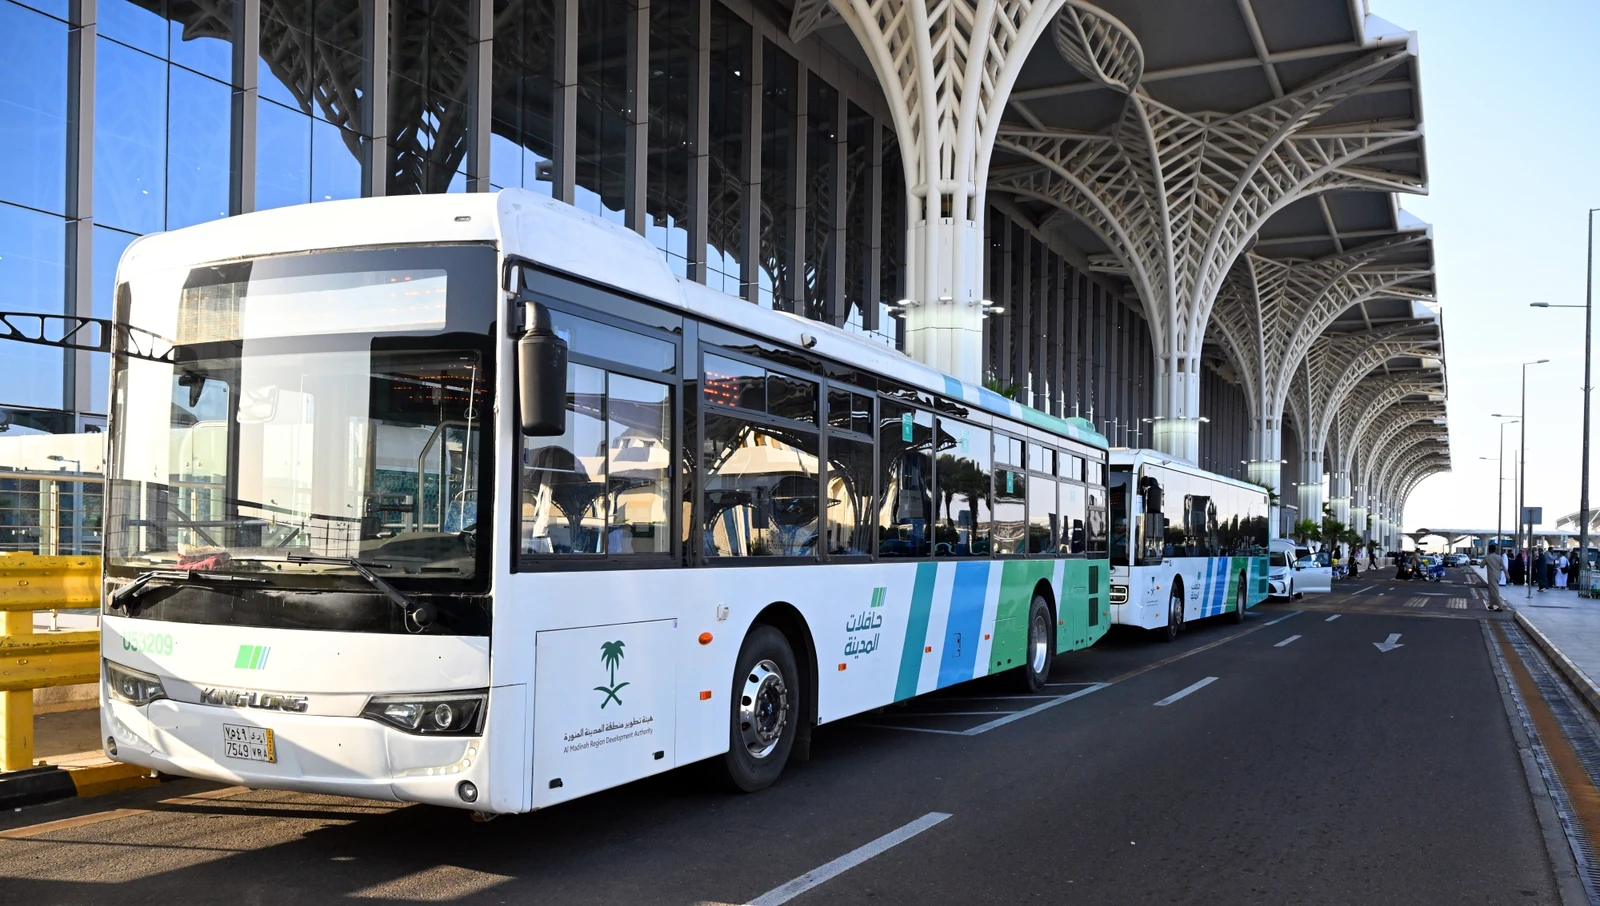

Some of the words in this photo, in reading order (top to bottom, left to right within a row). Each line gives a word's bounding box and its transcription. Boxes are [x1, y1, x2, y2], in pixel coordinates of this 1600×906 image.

[846, 611, 882, 632] حافلات
[122, 630, 174, 656] U53209
[844, 633, 880, 659] المدينة
[584, 723, 605, 737] المدينة
[605, 721, 624, 732] منطقة
[624, 717, 642, 729] تطوير
[563, 728, 584, 742] المنورة
[563, 746, 569, 754] Al
[569, 742, 589, 752] Madinah
[590, 738, 606, 748] Region
[605, 732, 634, 744] Development
[634, 727, 653, 737] Authority
[227, 742, 249, 757] 7549
